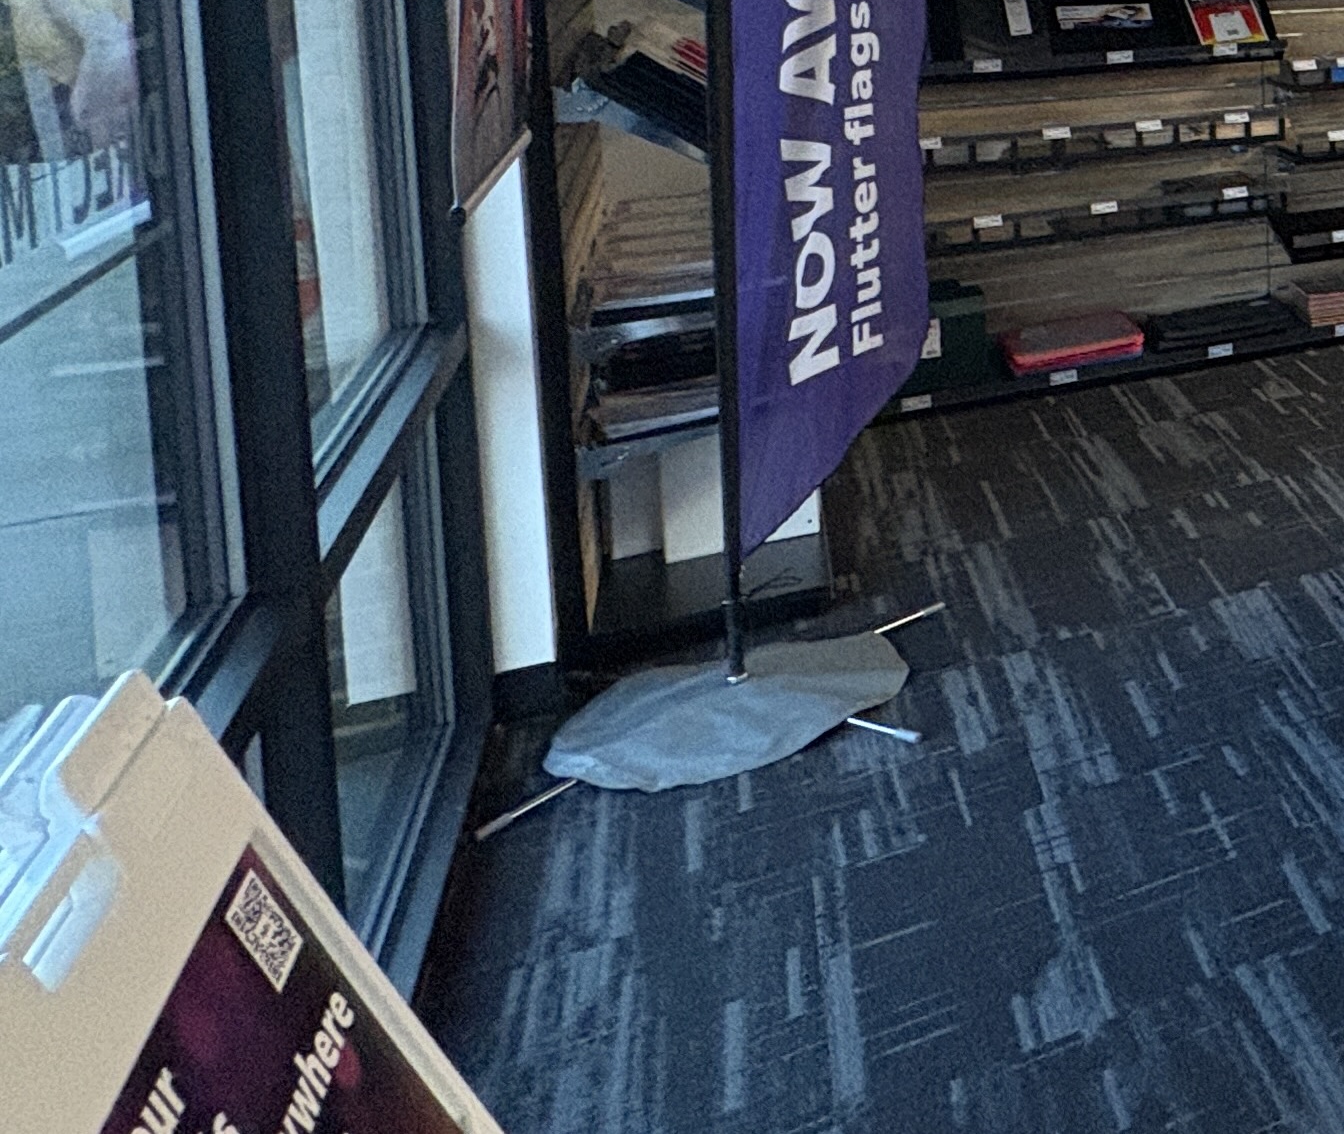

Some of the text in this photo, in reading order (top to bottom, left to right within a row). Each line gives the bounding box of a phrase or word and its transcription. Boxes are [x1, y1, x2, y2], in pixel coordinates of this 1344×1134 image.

[780, 138, 840, 386] NOW
[844, 1, 884, 356] Flutter flags
